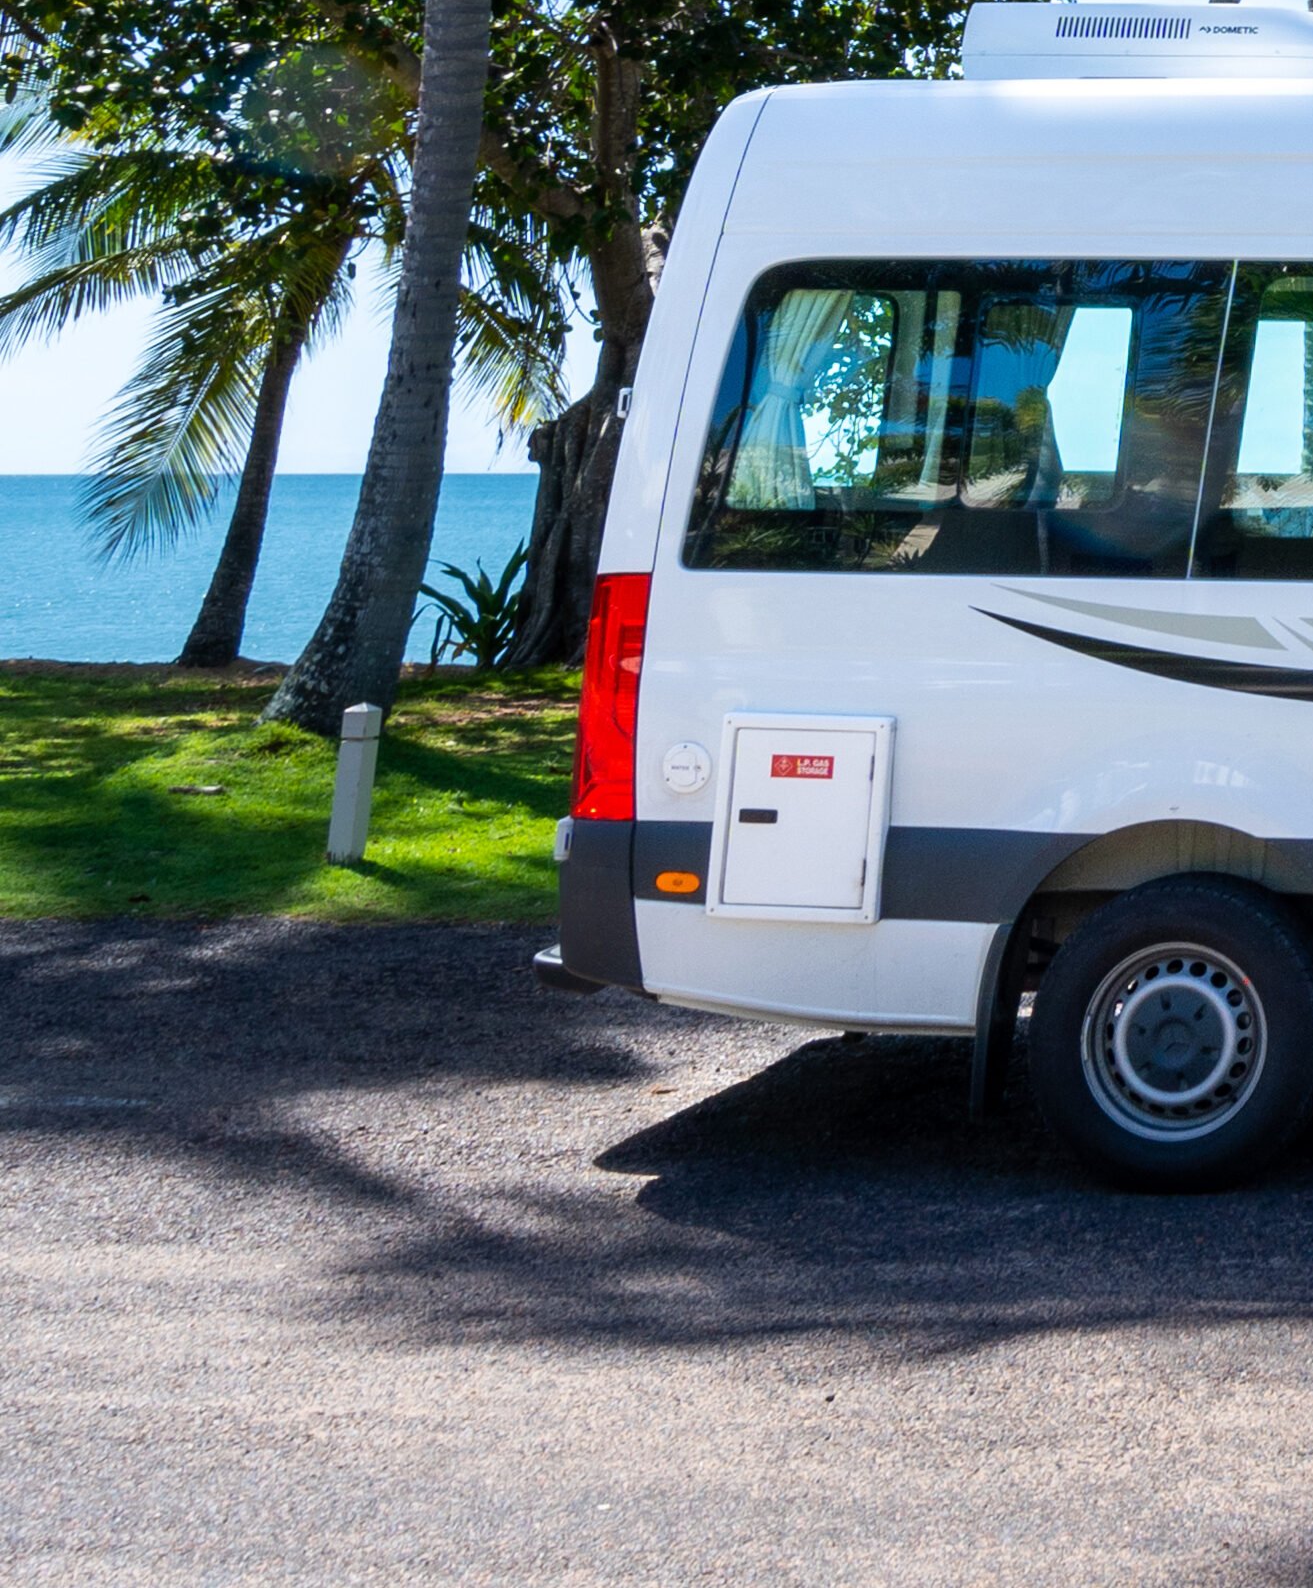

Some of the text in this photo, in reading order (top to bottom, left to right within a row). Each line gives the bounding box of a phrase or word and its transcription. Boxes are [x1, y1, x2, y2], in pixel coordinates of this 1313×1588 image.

[1212, 25, 1259, 35] DOMETIC
[812, 759, 830, 768] GAS
[796, 766, 829, 775] STORAGE
